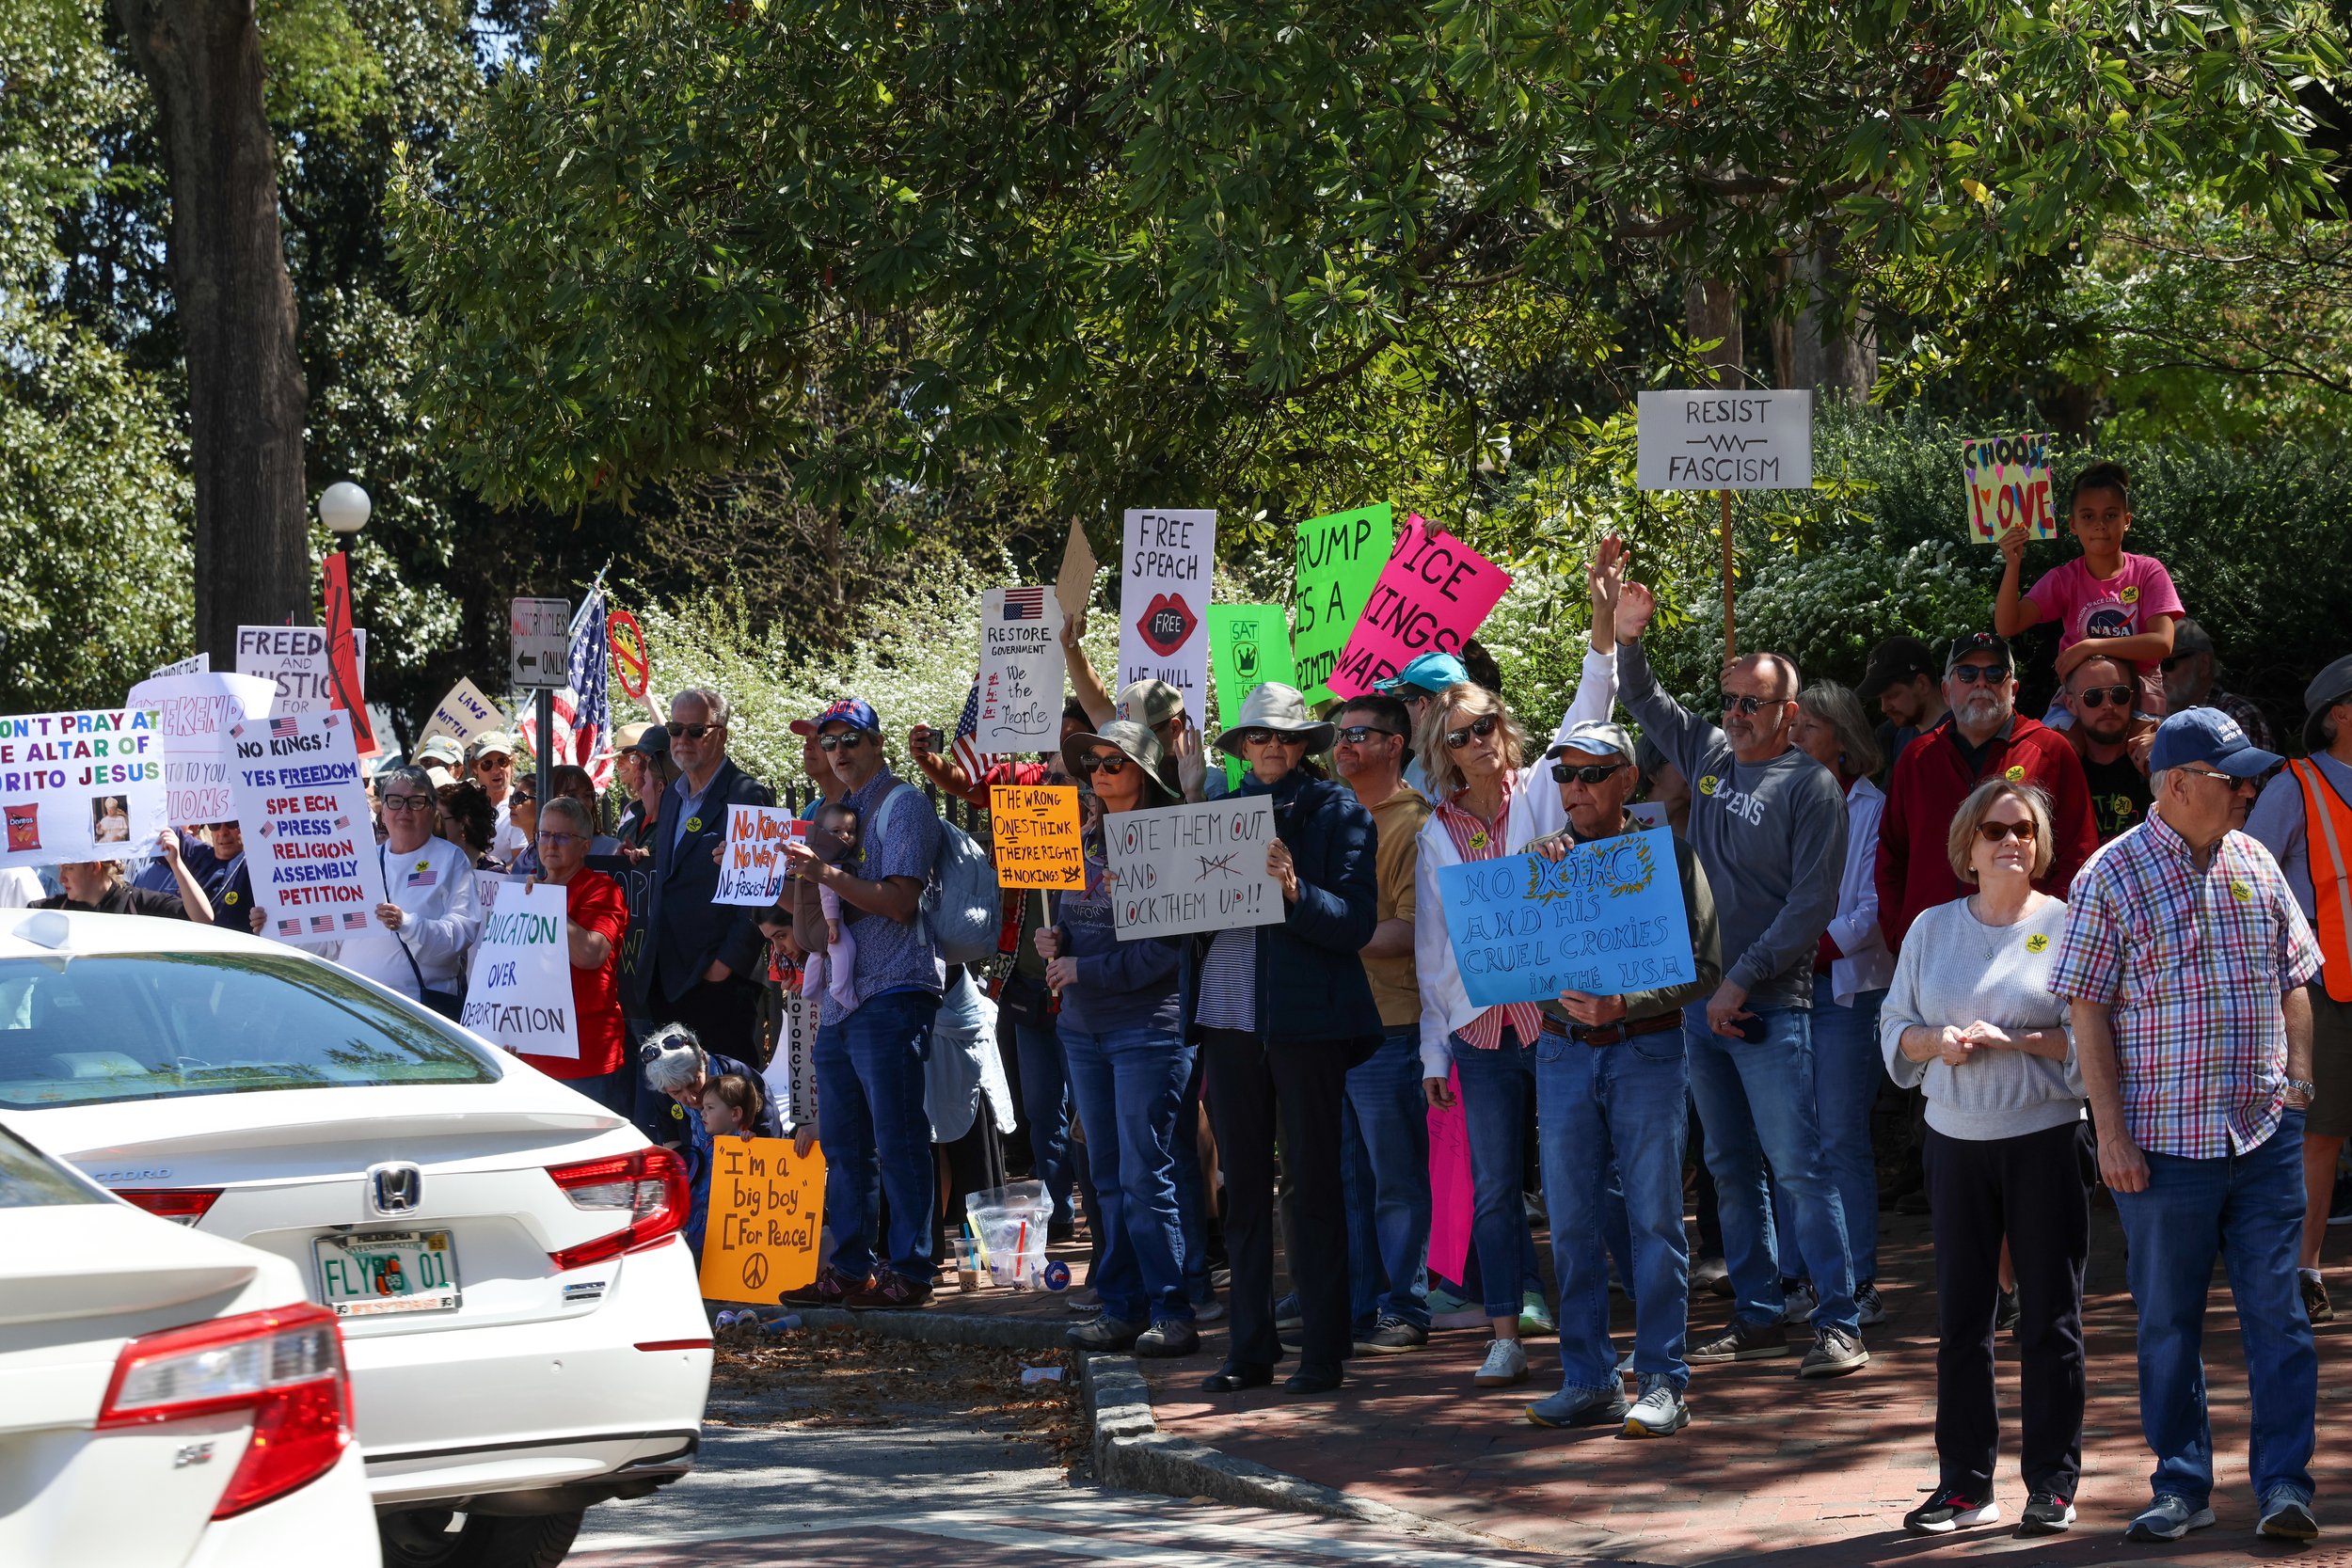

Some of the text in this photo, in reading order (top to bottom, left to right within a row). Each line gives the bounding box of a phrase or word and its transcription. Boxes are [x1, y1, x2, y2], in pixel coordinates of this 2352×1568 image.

[1687, 399, 1772, 423] RESIST
[1963, 436, 2049, 468] CHOOSE
[1669, 455, 1779, 482] FASCISM
[1972, 480, 2054, 536] LOVE
[1140, 515, 1195, 549] FREE
[1297, 519, 1372, 576] RUMP
[1132, 551, 1198, 580] SPEACH
[1402, 536, 1478, 603] ICE
[1296, 581, 1345, 635] IS A
[1363, 579, 1460, 653] KINGS
[514, 613, 565, 638] MOTORCYCLES
[988, 626, 1052, 643] RESTORE
[1155, 613, 1182, 634] FREE
[1232, 623, 1258, 641] SAT
[2090, 626, 2130, 636] NASA
[240, 631, 360, 657] FREED
[992, 644, 1046, 657] GOVERNMENT
[280, 657, 311, 669] AND
[542, 651, 565, 674] ONLY
[1006, 665, 1027, 681] We
[1295, 647, 1342, 692] RIMIN
[251, 671, 331, 698] STIC
[1009, 682, 1033, 698] the
[1129, 666, 1193, 689] WE WILL
[134, 695, 245, 736] EKEND
[282, 700, 309, 713] FOR
[458, 691, 487, 721] LAWS
[1002, 702, 1048, 732] People
[0, 711, 160, 737] ON'T PRAY AT
[437, 707, 467, 737] MATTER
[26, 739, 109, 762] ALTAR
[119, 736, 150, 754] OF
[237, 732, 331, 758] NO KINGS!
[0, 769, 66, 792] RITO
[79, 762, 160, 784] JESUS
[242, 762, 358, 786] YES FREEDOM
[167, 788, 229, 820] IONS
[993, 788, 1061, 810] THE WRONG
[1712, 779, 1765, 826] AENS
[277, 818, 331, 837] PRESS
[732, 811, 755, 843] No
[993, 816, 1073, 837] ONES THINK
[1108, 818, 1161, 857] VOTE
[1168, 813, 1221, 848] THEM
[273, 839, 354, 860] RELIGION
[734, 844, 751, 869] No
[1041, 846, 1078, 862] RIGHT
[273, 860, 358, 882] ASSEMBLY
[717, 869, 733, 898] No
[1115, 863, 1157, 895] AND
[278, 884, 364, 906] PETITION
[1460, 867, 1515, 906] NO
[1116, 882, 1263, 929] LOCK THEM UP!!
[482, 912, 557, 944] EDUCATION
[1462, 905, 1541, 944] AND
[1464, 941, 1550, 974] CRUEL
[487, 961, 516, 988] OVER
[1564, 965, 1602, 990] THE
[1618, 956, 1684, 988] USA
[461, 1002, 564, 1034] DEPORTATION
[94, 1168, 173, 1183] CCORD
[776, 1157, 790, 1177] a
[734, 1178, 760, 1217] big
[420, 1252, 450, 1289] 01
